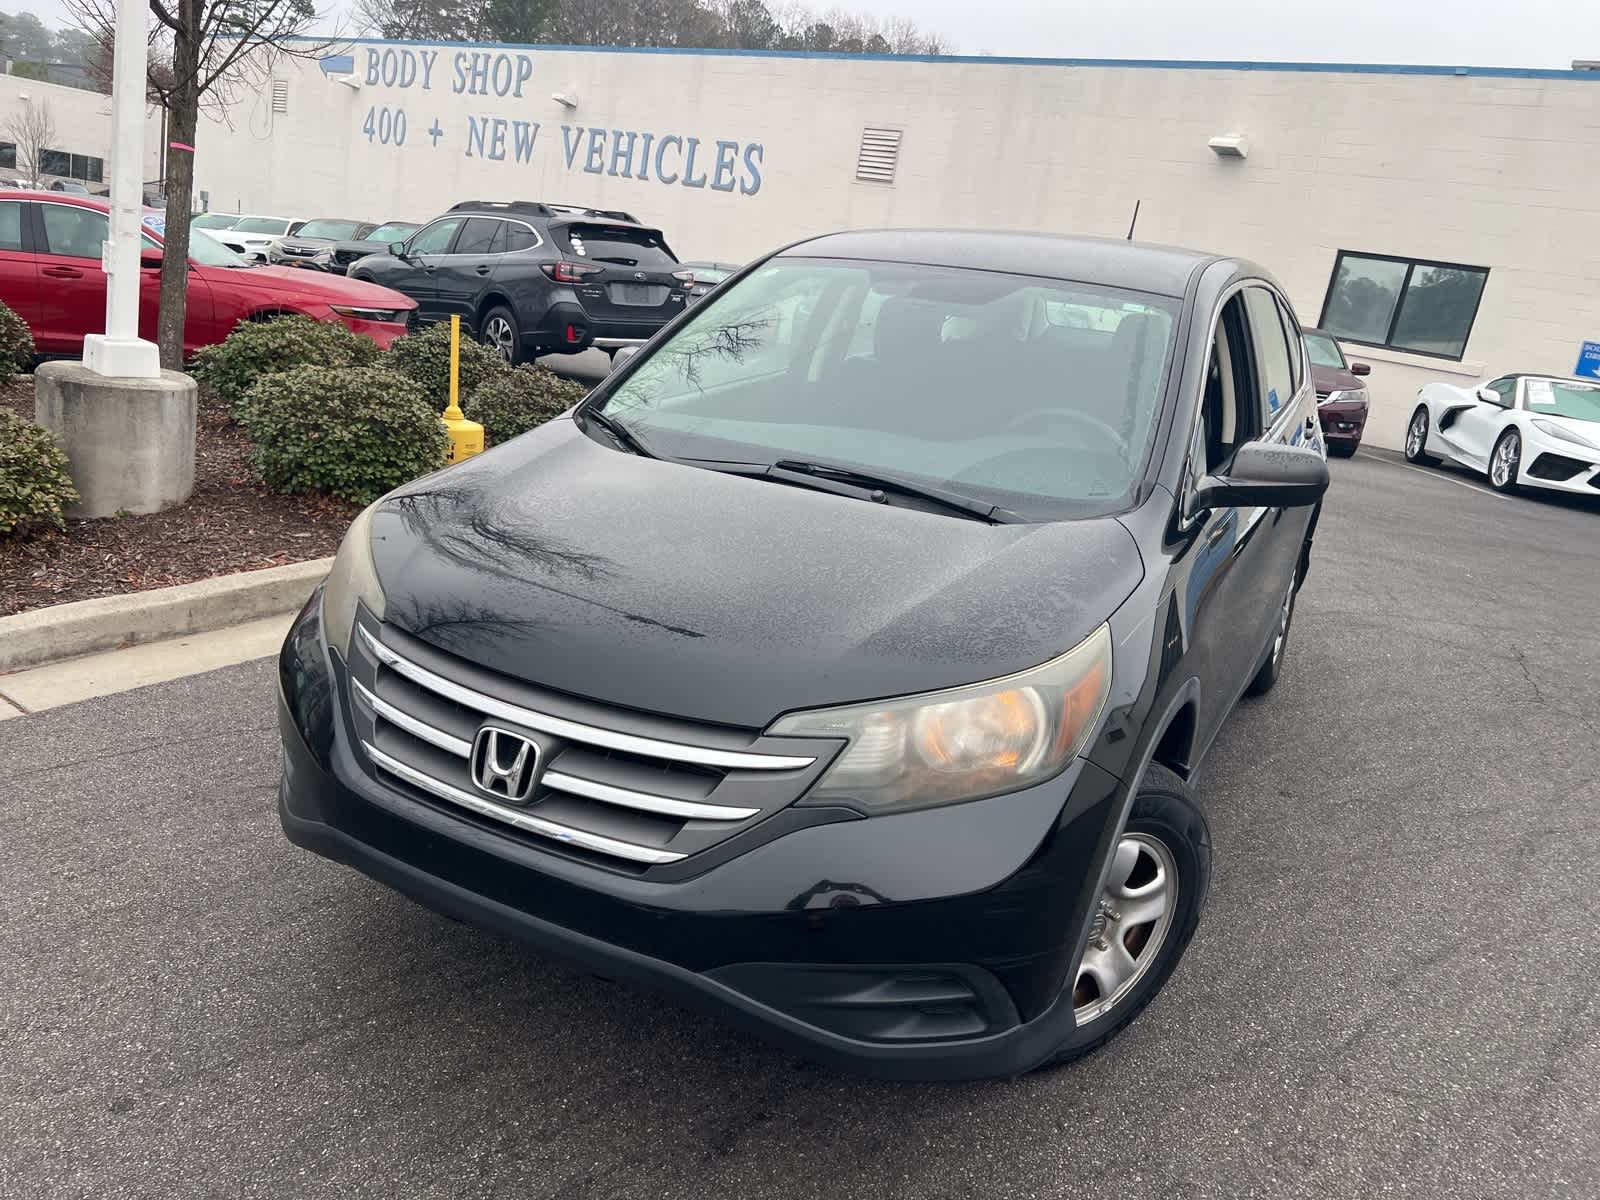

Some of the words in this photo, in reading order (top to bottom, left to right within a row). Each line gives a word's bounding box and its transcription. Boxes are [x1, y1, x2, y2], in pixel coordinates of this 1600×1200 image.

[365, 47, 438, 90] BODY
[452, 51, 533, 98] SHOP
[362, 105, 407, 147] 400
[428, 117, 444, 147] +
[465, 115, 541, 164] NEW
[560, 125, 764, 197] VEHICLES
